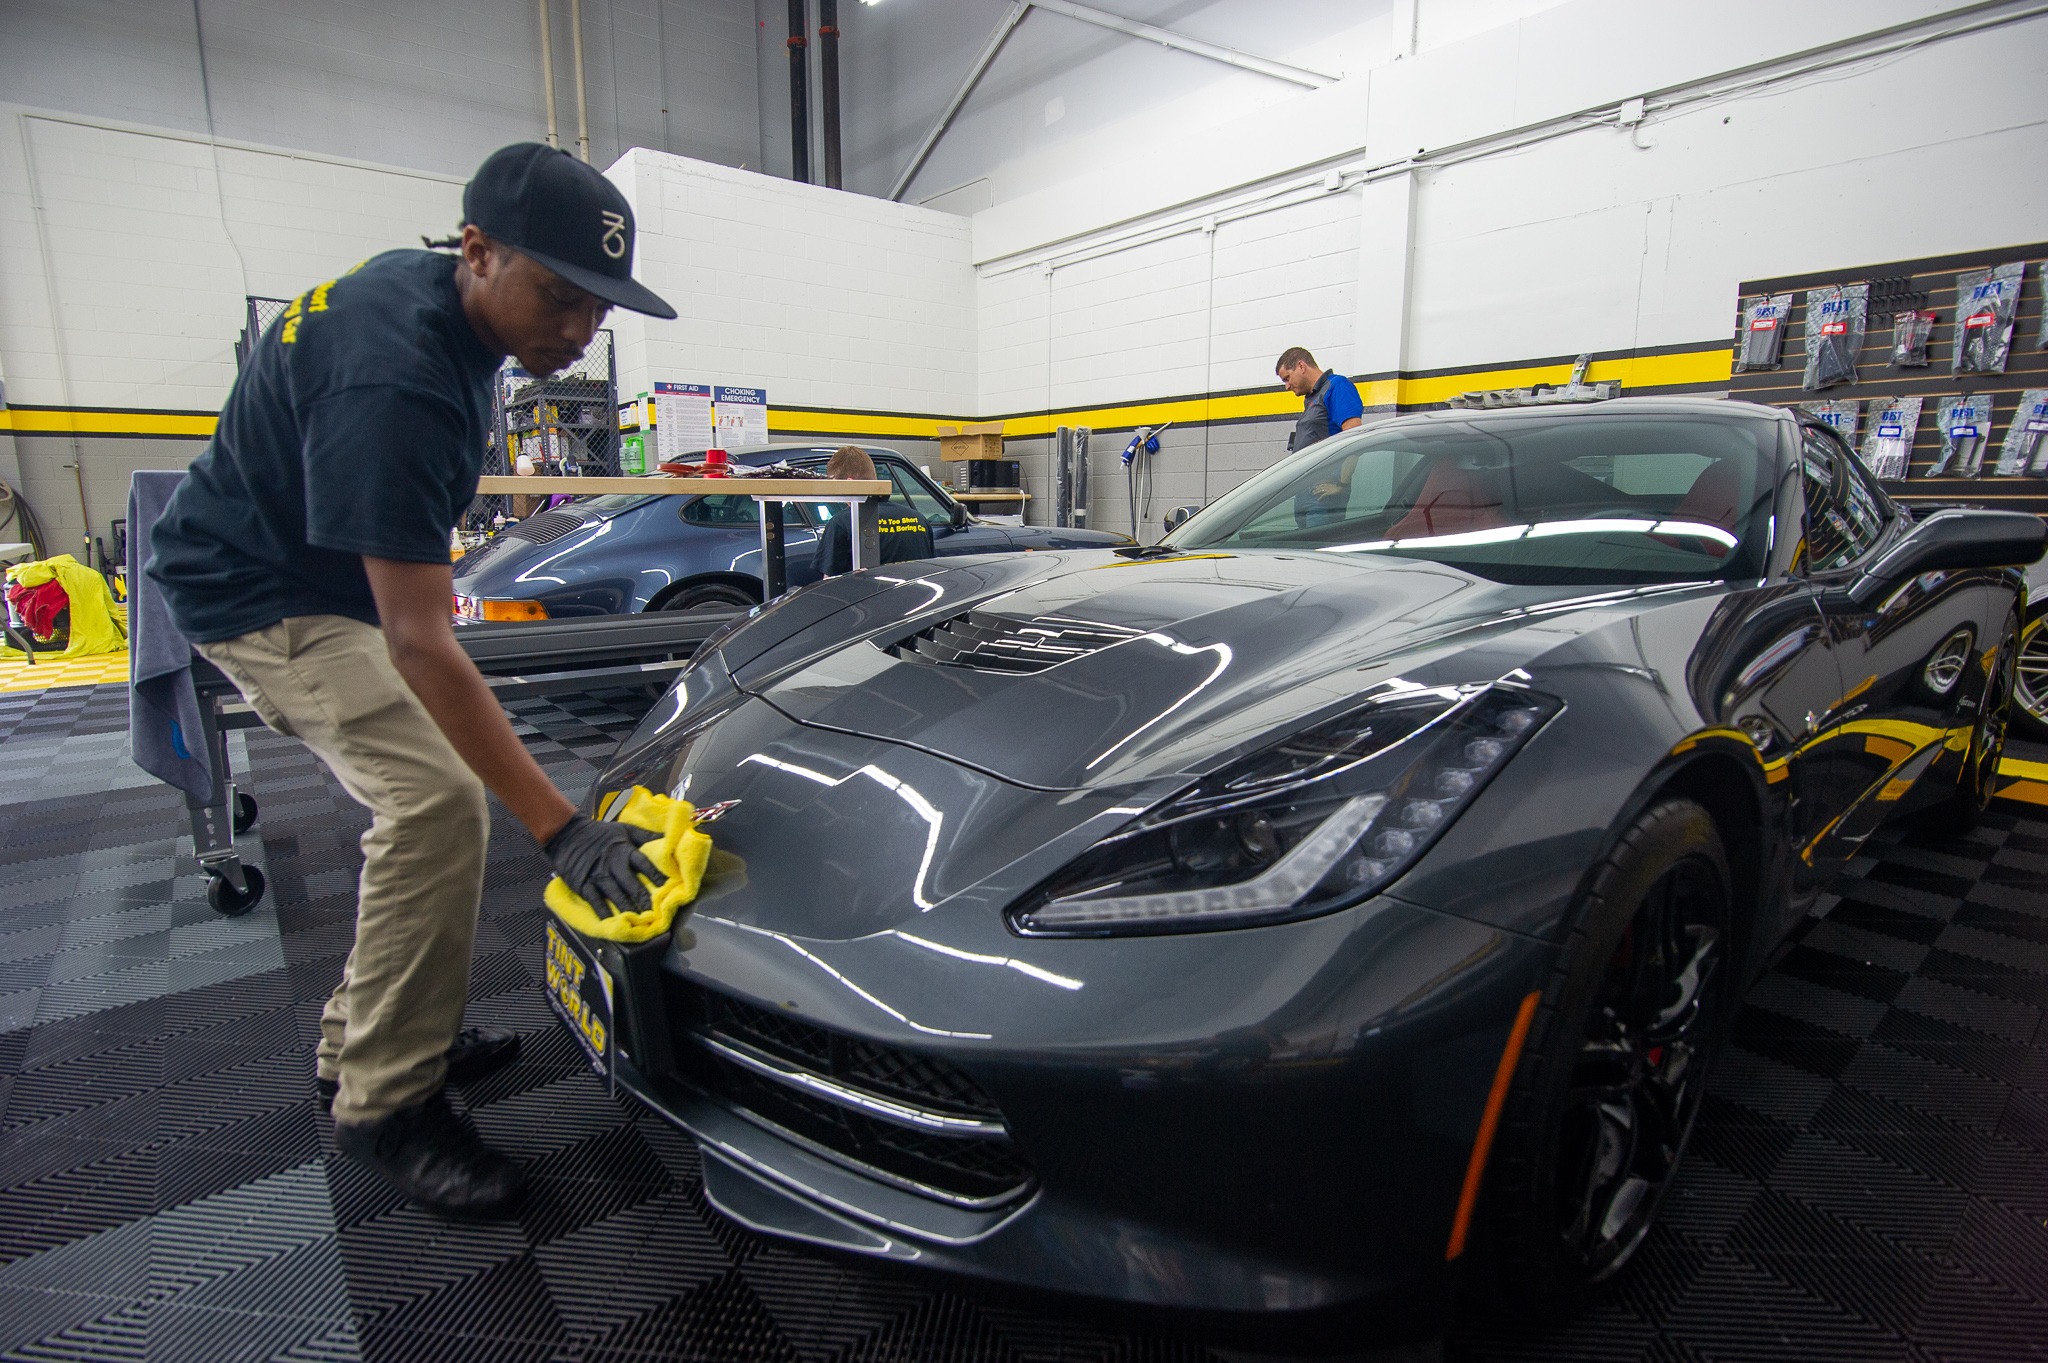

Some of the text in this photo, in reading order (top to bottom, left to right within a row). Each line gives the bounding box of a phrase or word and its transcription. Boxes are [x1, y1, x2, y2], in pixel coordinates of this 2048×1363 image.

[720, 394, 761, 404] EMERGENCY
[724, 387, 756, 396] CHOKING
[546, 922, 586, 990] TINT
[546, 954, 607, 1057] WORLD
